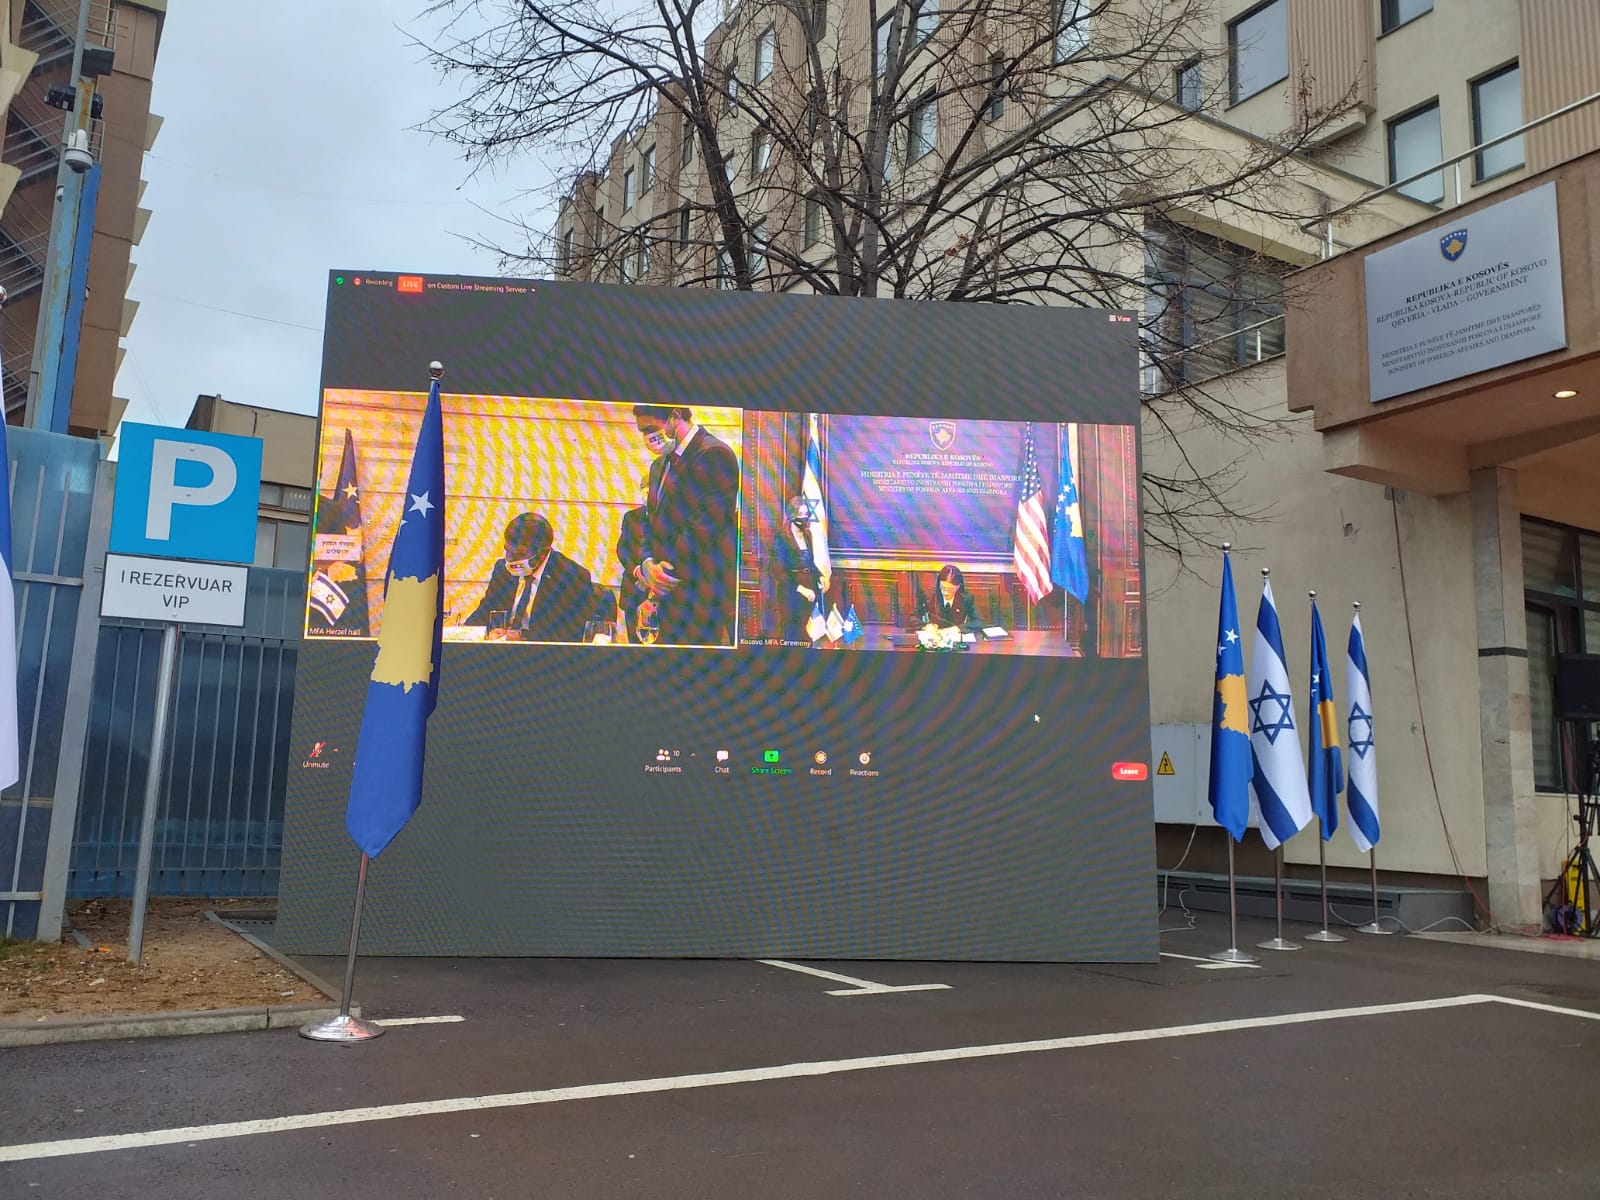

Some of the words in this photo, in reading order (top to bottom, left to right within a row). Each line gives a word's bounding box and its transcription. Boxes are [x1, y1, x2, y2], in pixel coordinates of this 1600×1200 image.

[365, 277, 393, 287] Recording
[402, 281, 420, 290] LIVE
[436, 282, 460, 290] Custom
[460, 283, 473, 291] Live
[474, 284, 505, 293] Streaming
[505, 285, 528, 294] Service
[1405, 281, 1456, 304] REPUBLIKA
[1457, 278, 1464, 286] E
[1465, 261, 1510, 283] KOSOVËS
[1375, 304, 1418, 324] REPUBLIKA
[1496, 271, 1508, 282] OF
[1510, 258, 1548, 278] KOSOVO
[1391, 311, 1426, 329] QEVERIA
[1431, 299, 1459, 314] VLADA
[1466, 274, 1529, 303] GOVERNMENT
[145, 438, 237, 541] P
[129, 571, 233, 593] REZERVUAR
[162, 594, 190, 609] VIP
[309, 627, 324, 636] MFA
[740, 638, 763, 646] Kosovo
[764, 639, 778, 647] MFA
[779, 640, 811, 649] Ceremony
[302, 761, 330, 769] Unmute
[644, 765, 682, 774] Participants
[751, 766, 770, 775] Share
[771, 767, 792, 775] Screen
[810, 767, 832, 776] Record
[849, 768, 879, 777] Reactions
[1120, 767, 1140, 776] Leave
